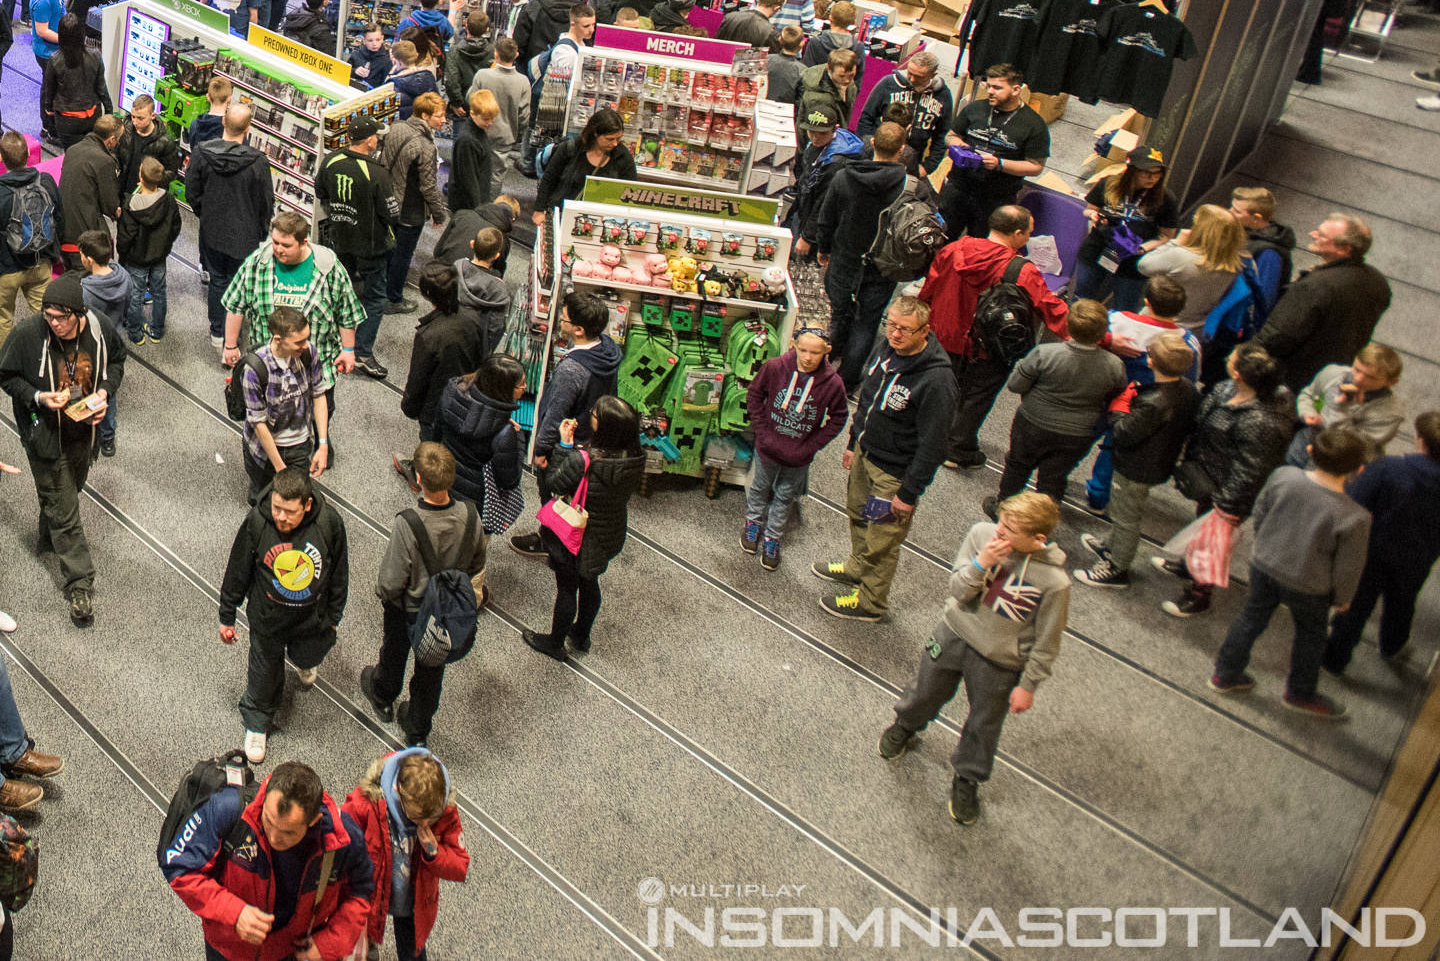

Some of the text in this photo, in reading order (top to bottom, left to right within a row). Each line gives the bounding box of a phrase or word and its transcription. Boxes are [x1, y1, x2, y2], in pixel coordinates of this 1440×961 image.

[180, 2, 201, 18] XBOX
[263, 35, 333, 75] PREOWNED XBOX ONE
[646, 37, 696, 56] MERCH
[620, 187, 741, 216] MINECRAFT
[770, 411, 813, 433] WILDCATS
[166, 818, 198, 865] Audi
